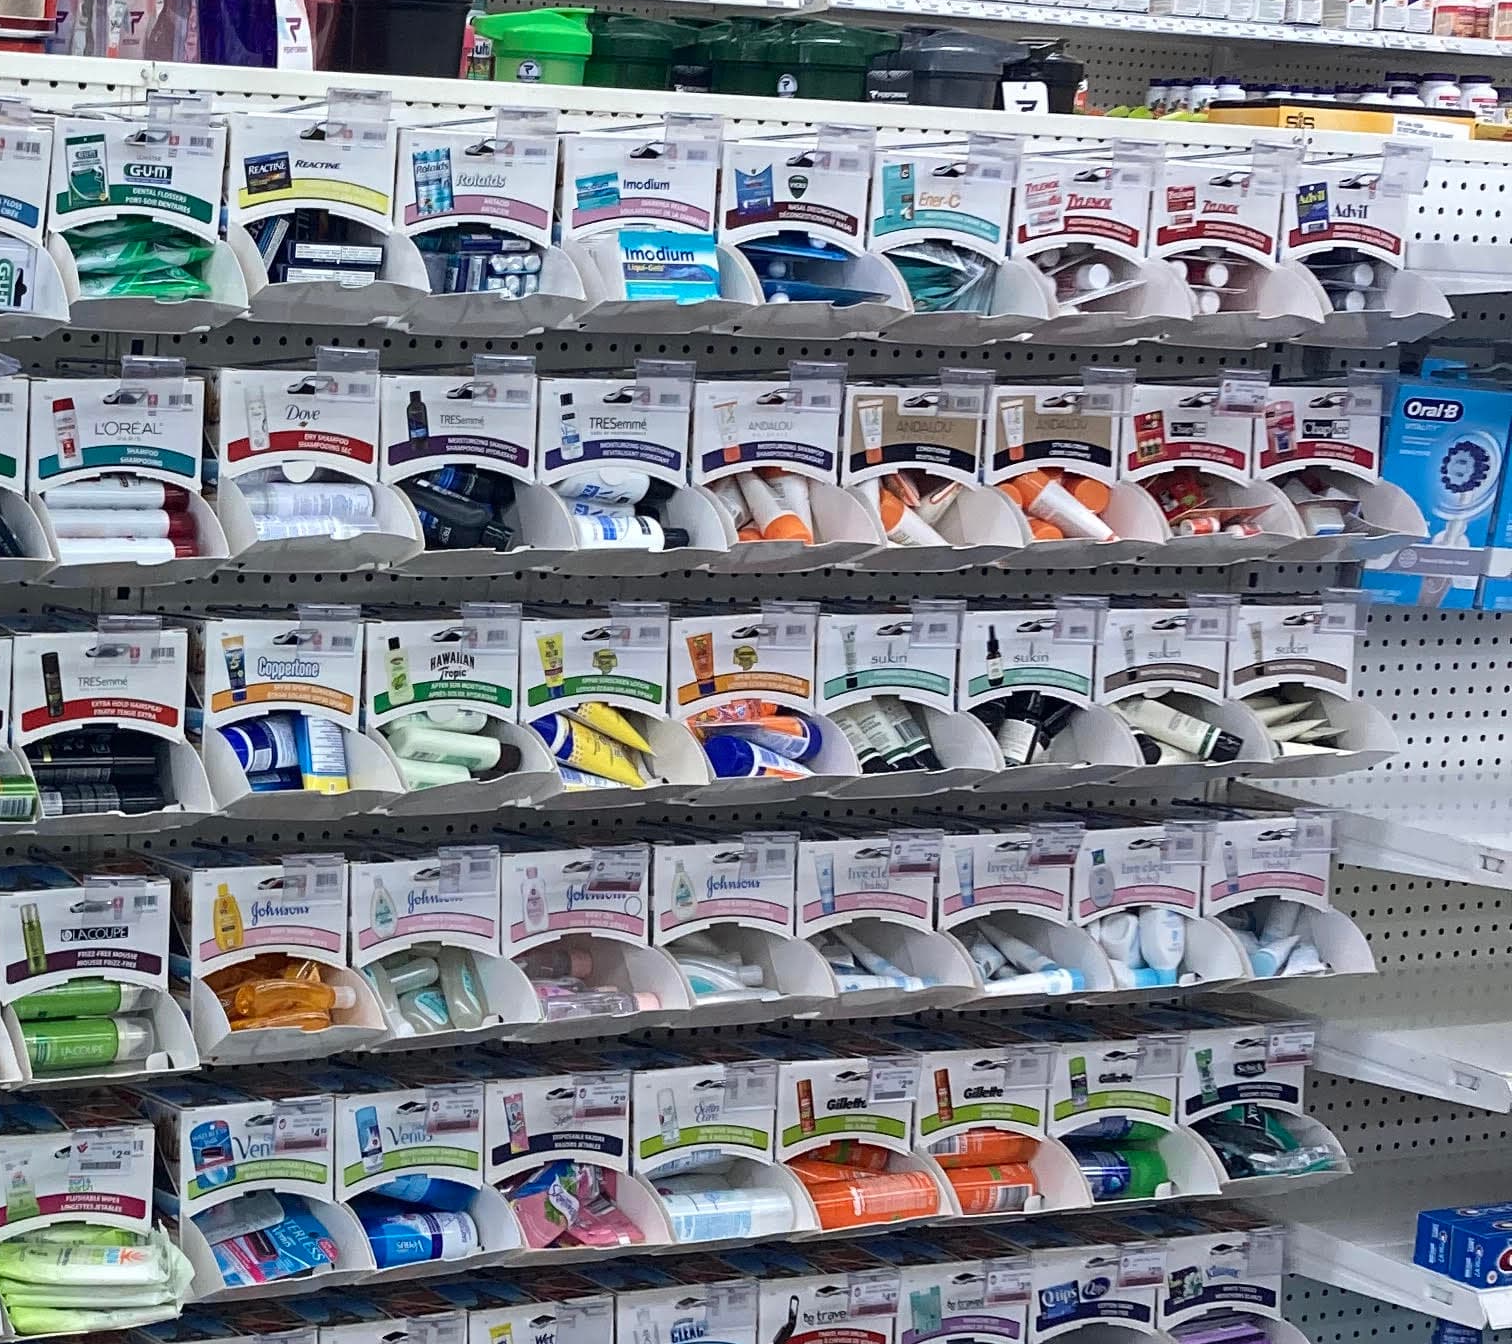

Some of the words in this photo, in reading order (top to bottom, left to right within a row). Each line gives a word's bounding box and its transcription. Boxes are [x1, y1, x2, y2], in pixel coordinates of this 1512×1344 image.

[248, 160, 287, 175] REACTINE
[456, 173, 507, 188] Rolaids
[623, 179, 670, 191] Imodium
[919, 192, 960, 208] Ener-C
[1333, 204, 1368, 220] Advil
[625, 246, 695, 263] Imodium
[287, 404, 320, 421] Dove
[1407, 402, 1458, 418] Oral-B
[590, 417, 647, 430] TRESemmé
[430, 652, 475, 670] HAWAIIAN
[1013, 652, 1050, 664] sukin
[258, 657, 319, 678] Coppertone
[438, 666, 467, 680] Tropic
[78, 677, 128, 688] TRESemmé
[964, 1086, 1003, 1100] Gillette
